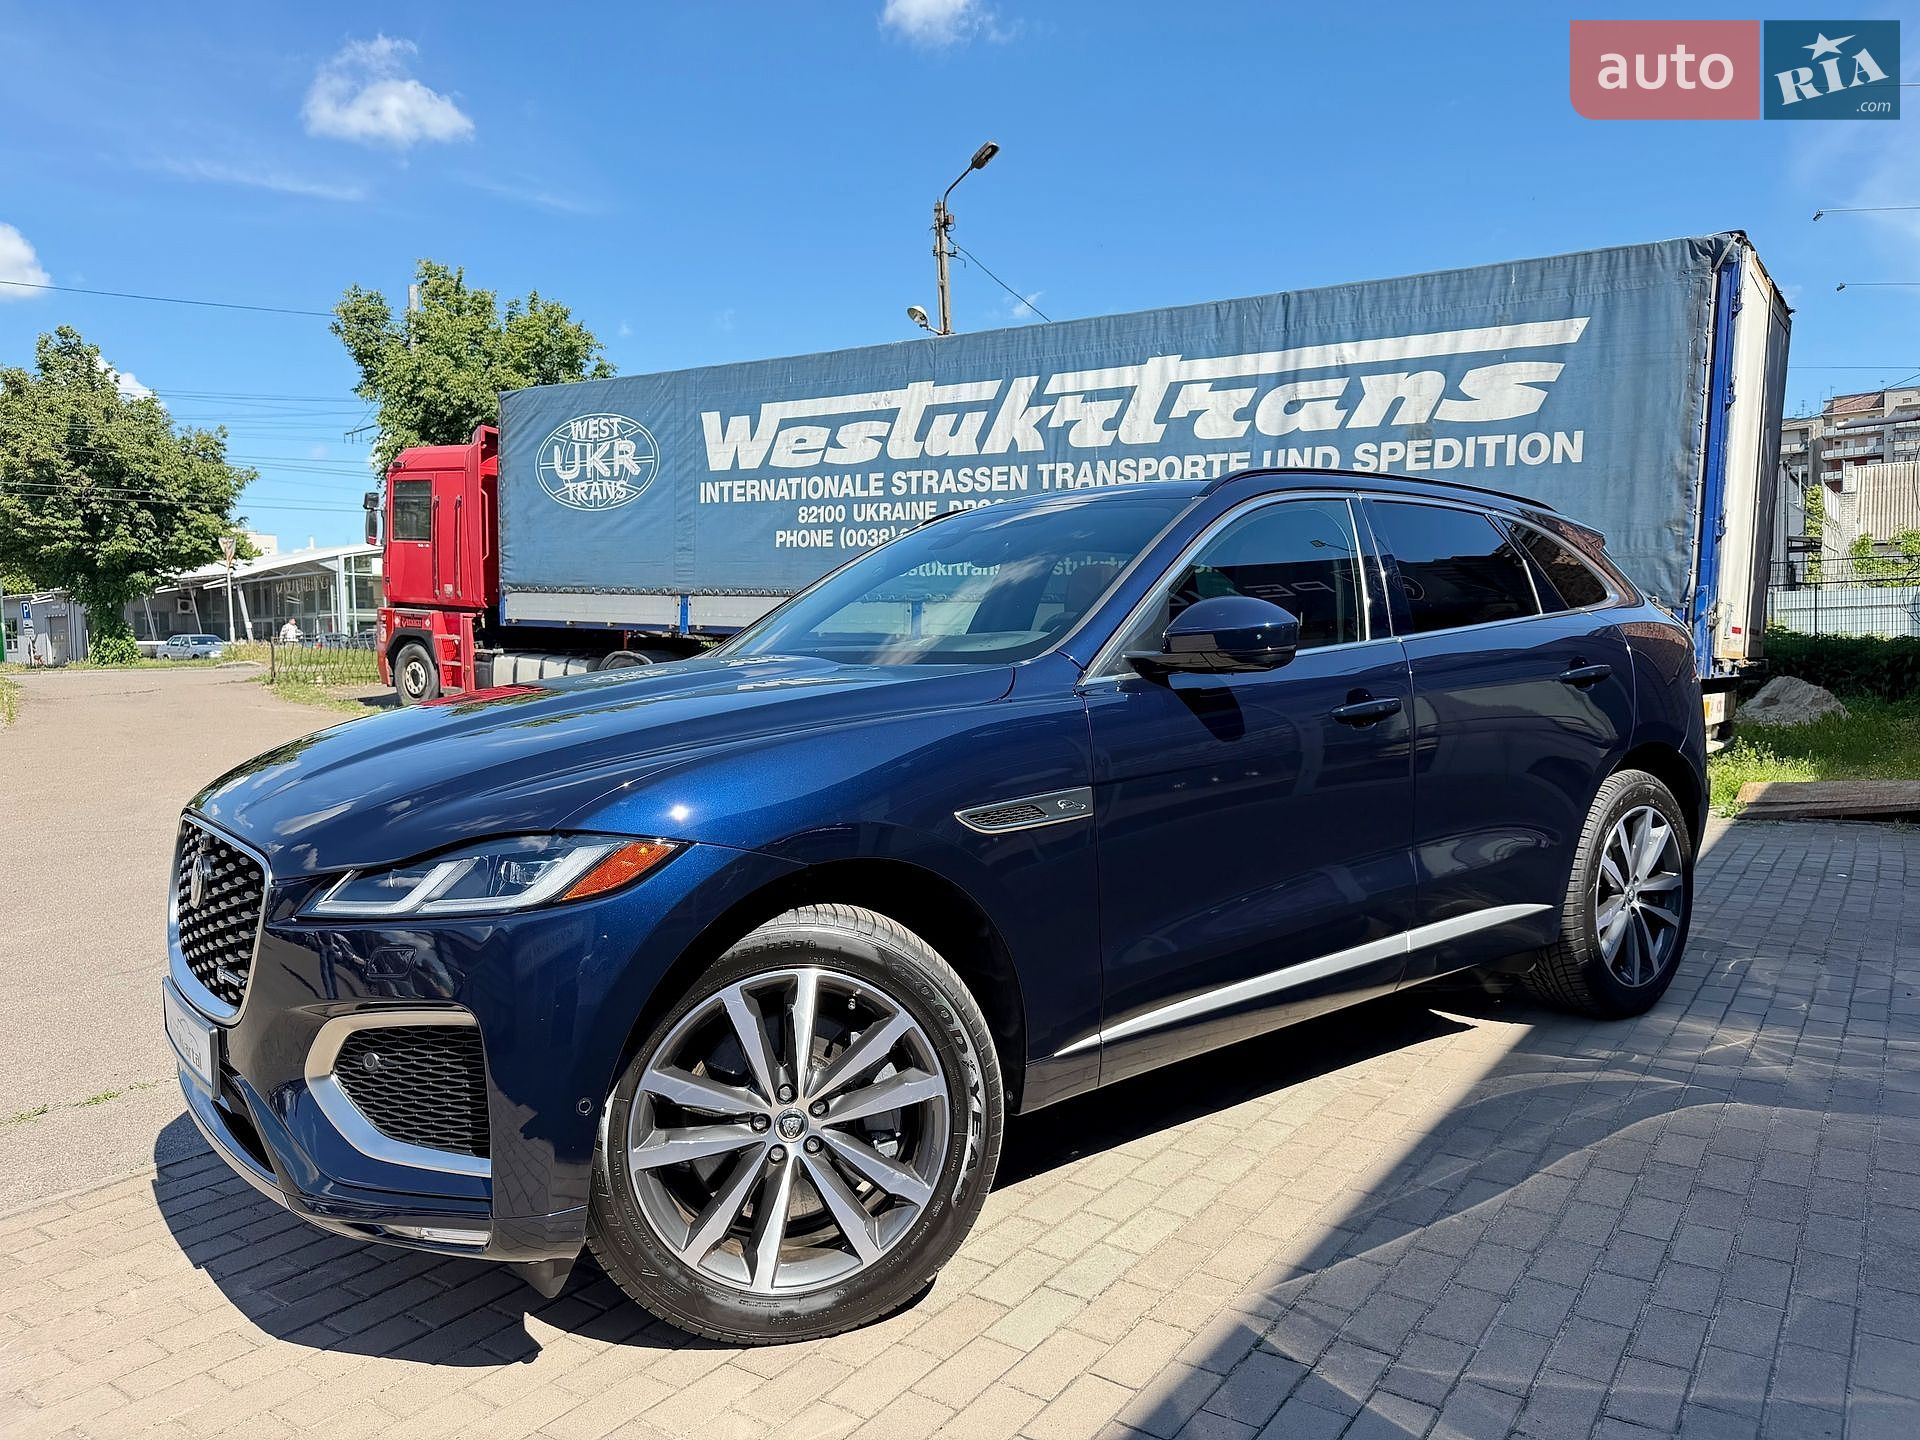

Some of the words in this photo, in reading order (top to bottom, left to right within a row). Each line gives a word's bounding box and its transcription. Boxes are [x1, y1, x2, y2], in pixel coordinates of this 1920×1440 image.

[701, 317, 1590, 471] Westukrtrans
[570, 418, 622, 440] WEST
[554, 439, 641, 480] UKR
[700, 473, 885, 504] INTERNATIONALE
[891, 464, 1028, 495] STRASSEN
[1037, 452, 1250, 490] TRANSPORTE
[1263, 446, 1340, 470] UND
[1352, 430, 1584, 473] SPEDITION
[568, 480, 627, 500] TRANS
[798, 504, 846, 524] 82100
[853, 501, 936, 523] UKRAINE
[775, 529, 833, 548] PHONE
